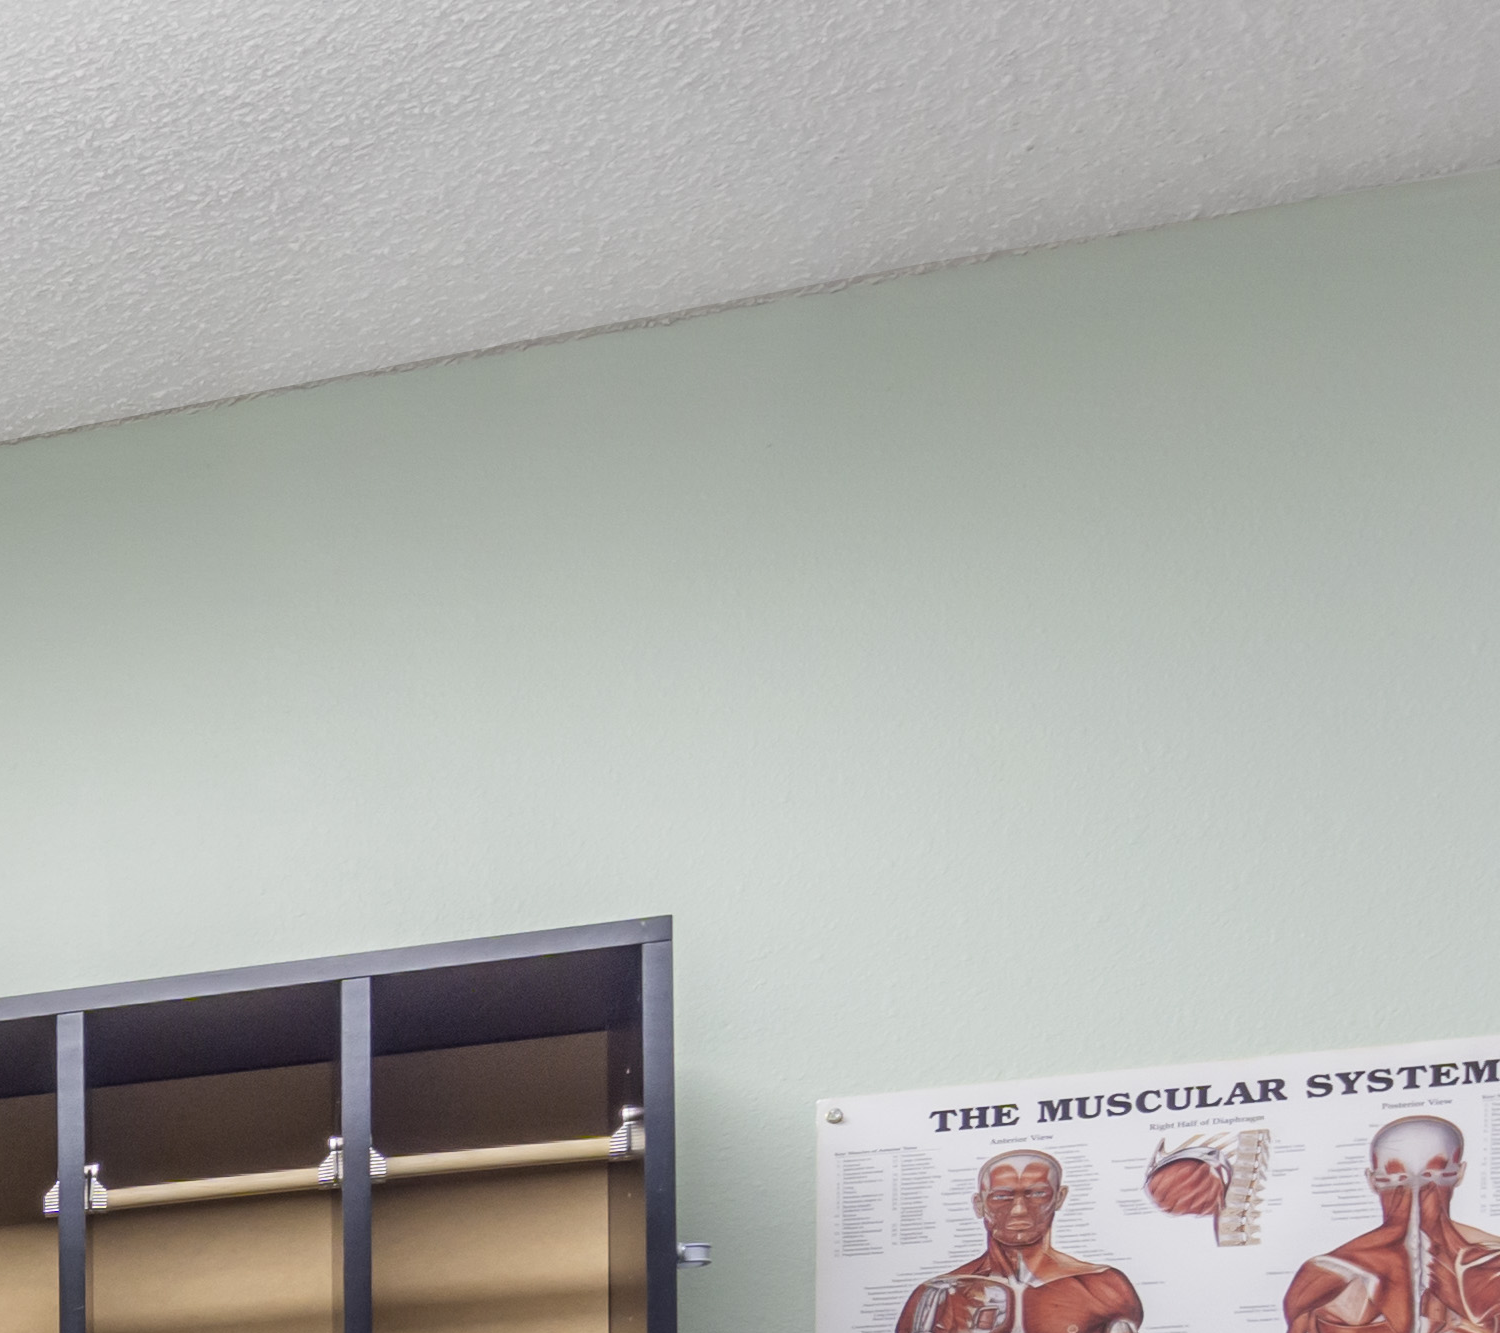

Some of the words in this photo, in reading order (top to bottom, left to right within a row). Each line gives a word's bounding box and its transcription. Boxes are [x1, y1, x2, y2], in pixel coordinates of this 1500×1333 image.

[928, 1103, 1020, 1133] THE
[1037, 1078, 1288, 1124] MUSCULAR
[1305, 1058, 1500, 1099] SYSTEM
[1381, 1101, 1426, 1110] Posterior
[1428, 1099, 1453, 1107] View
[1149, 1123, 1175, 1132] Right
[1177, 1119, 1197, 1128] Half
[1212, 1115, 1265, 1126] Diaphragm
[990, 1136, 1027, 1146] Anterior
[1030, 1134, 1054, 1142] View
